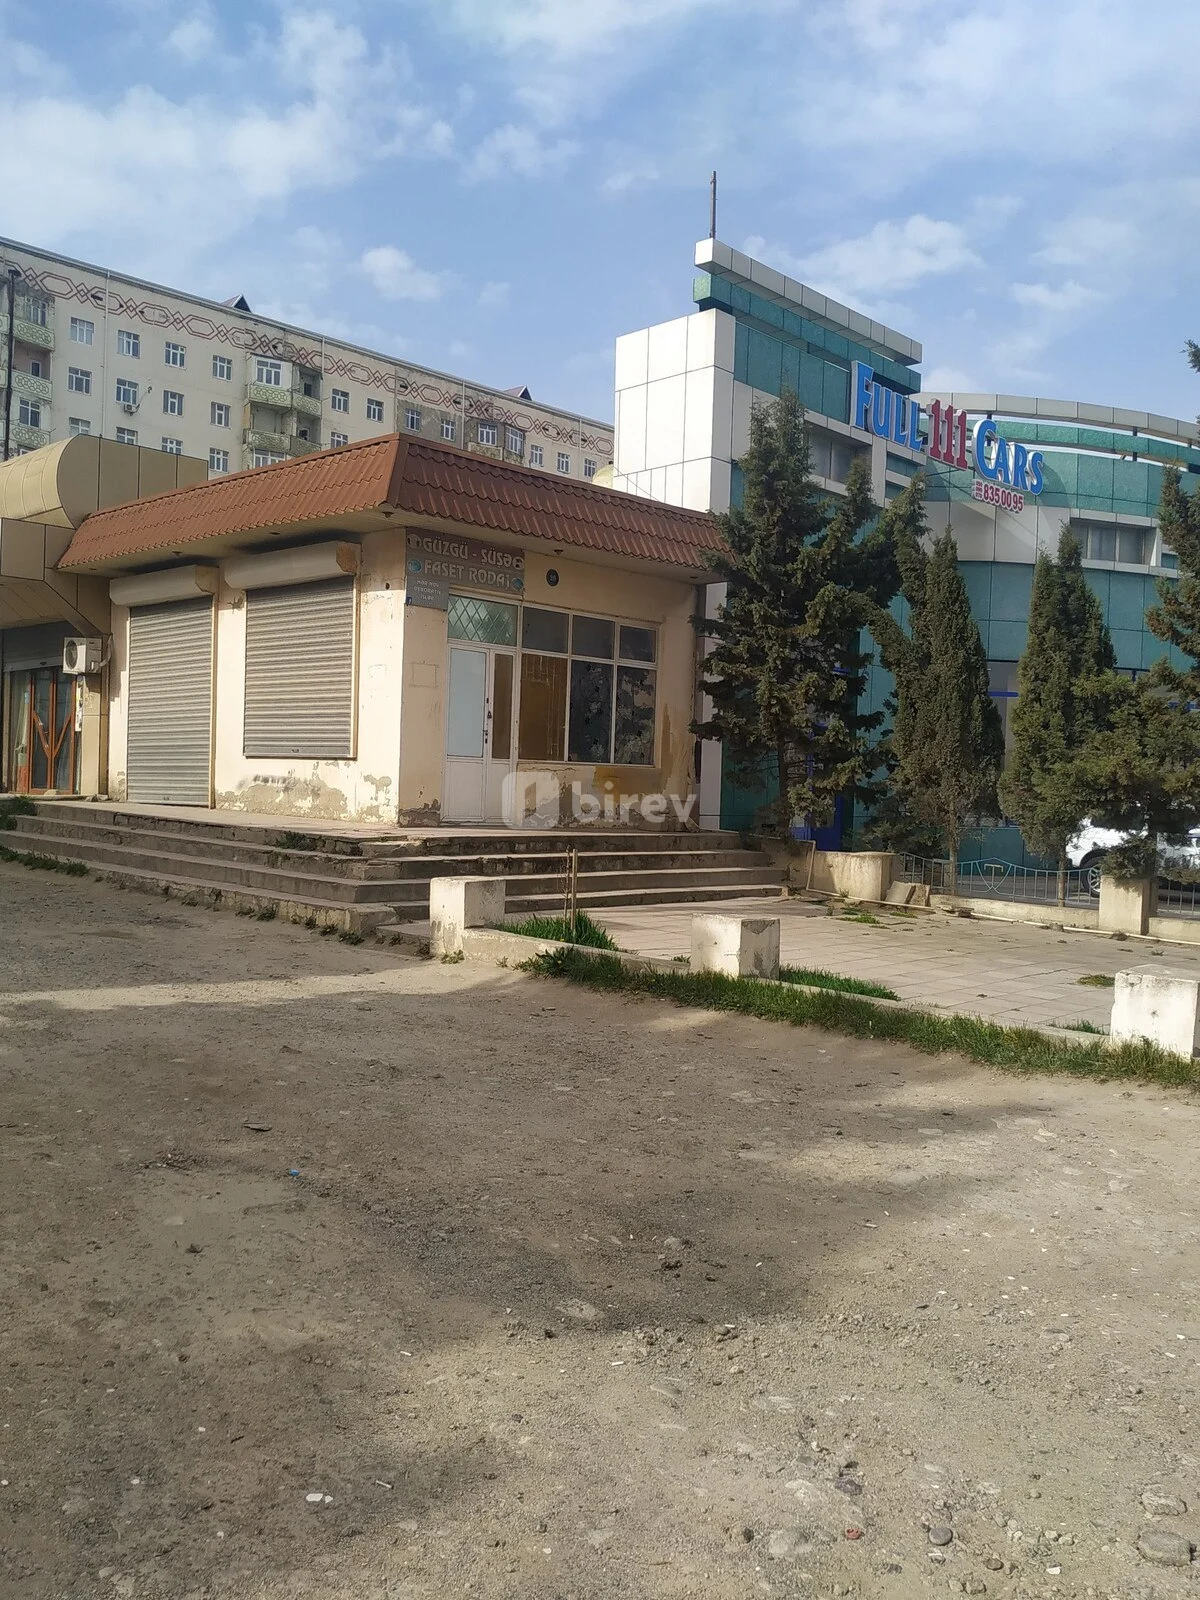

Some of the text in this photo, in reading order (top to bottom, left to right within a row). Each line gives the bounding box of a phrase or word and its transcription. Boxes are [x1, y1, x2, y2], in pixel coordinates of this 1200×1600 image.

[852, 360, 1044, 495] FULL 111 CARS
[422, 536, 468, 560] GÜZGÜ
[424, 560, 464, 580] FASET
